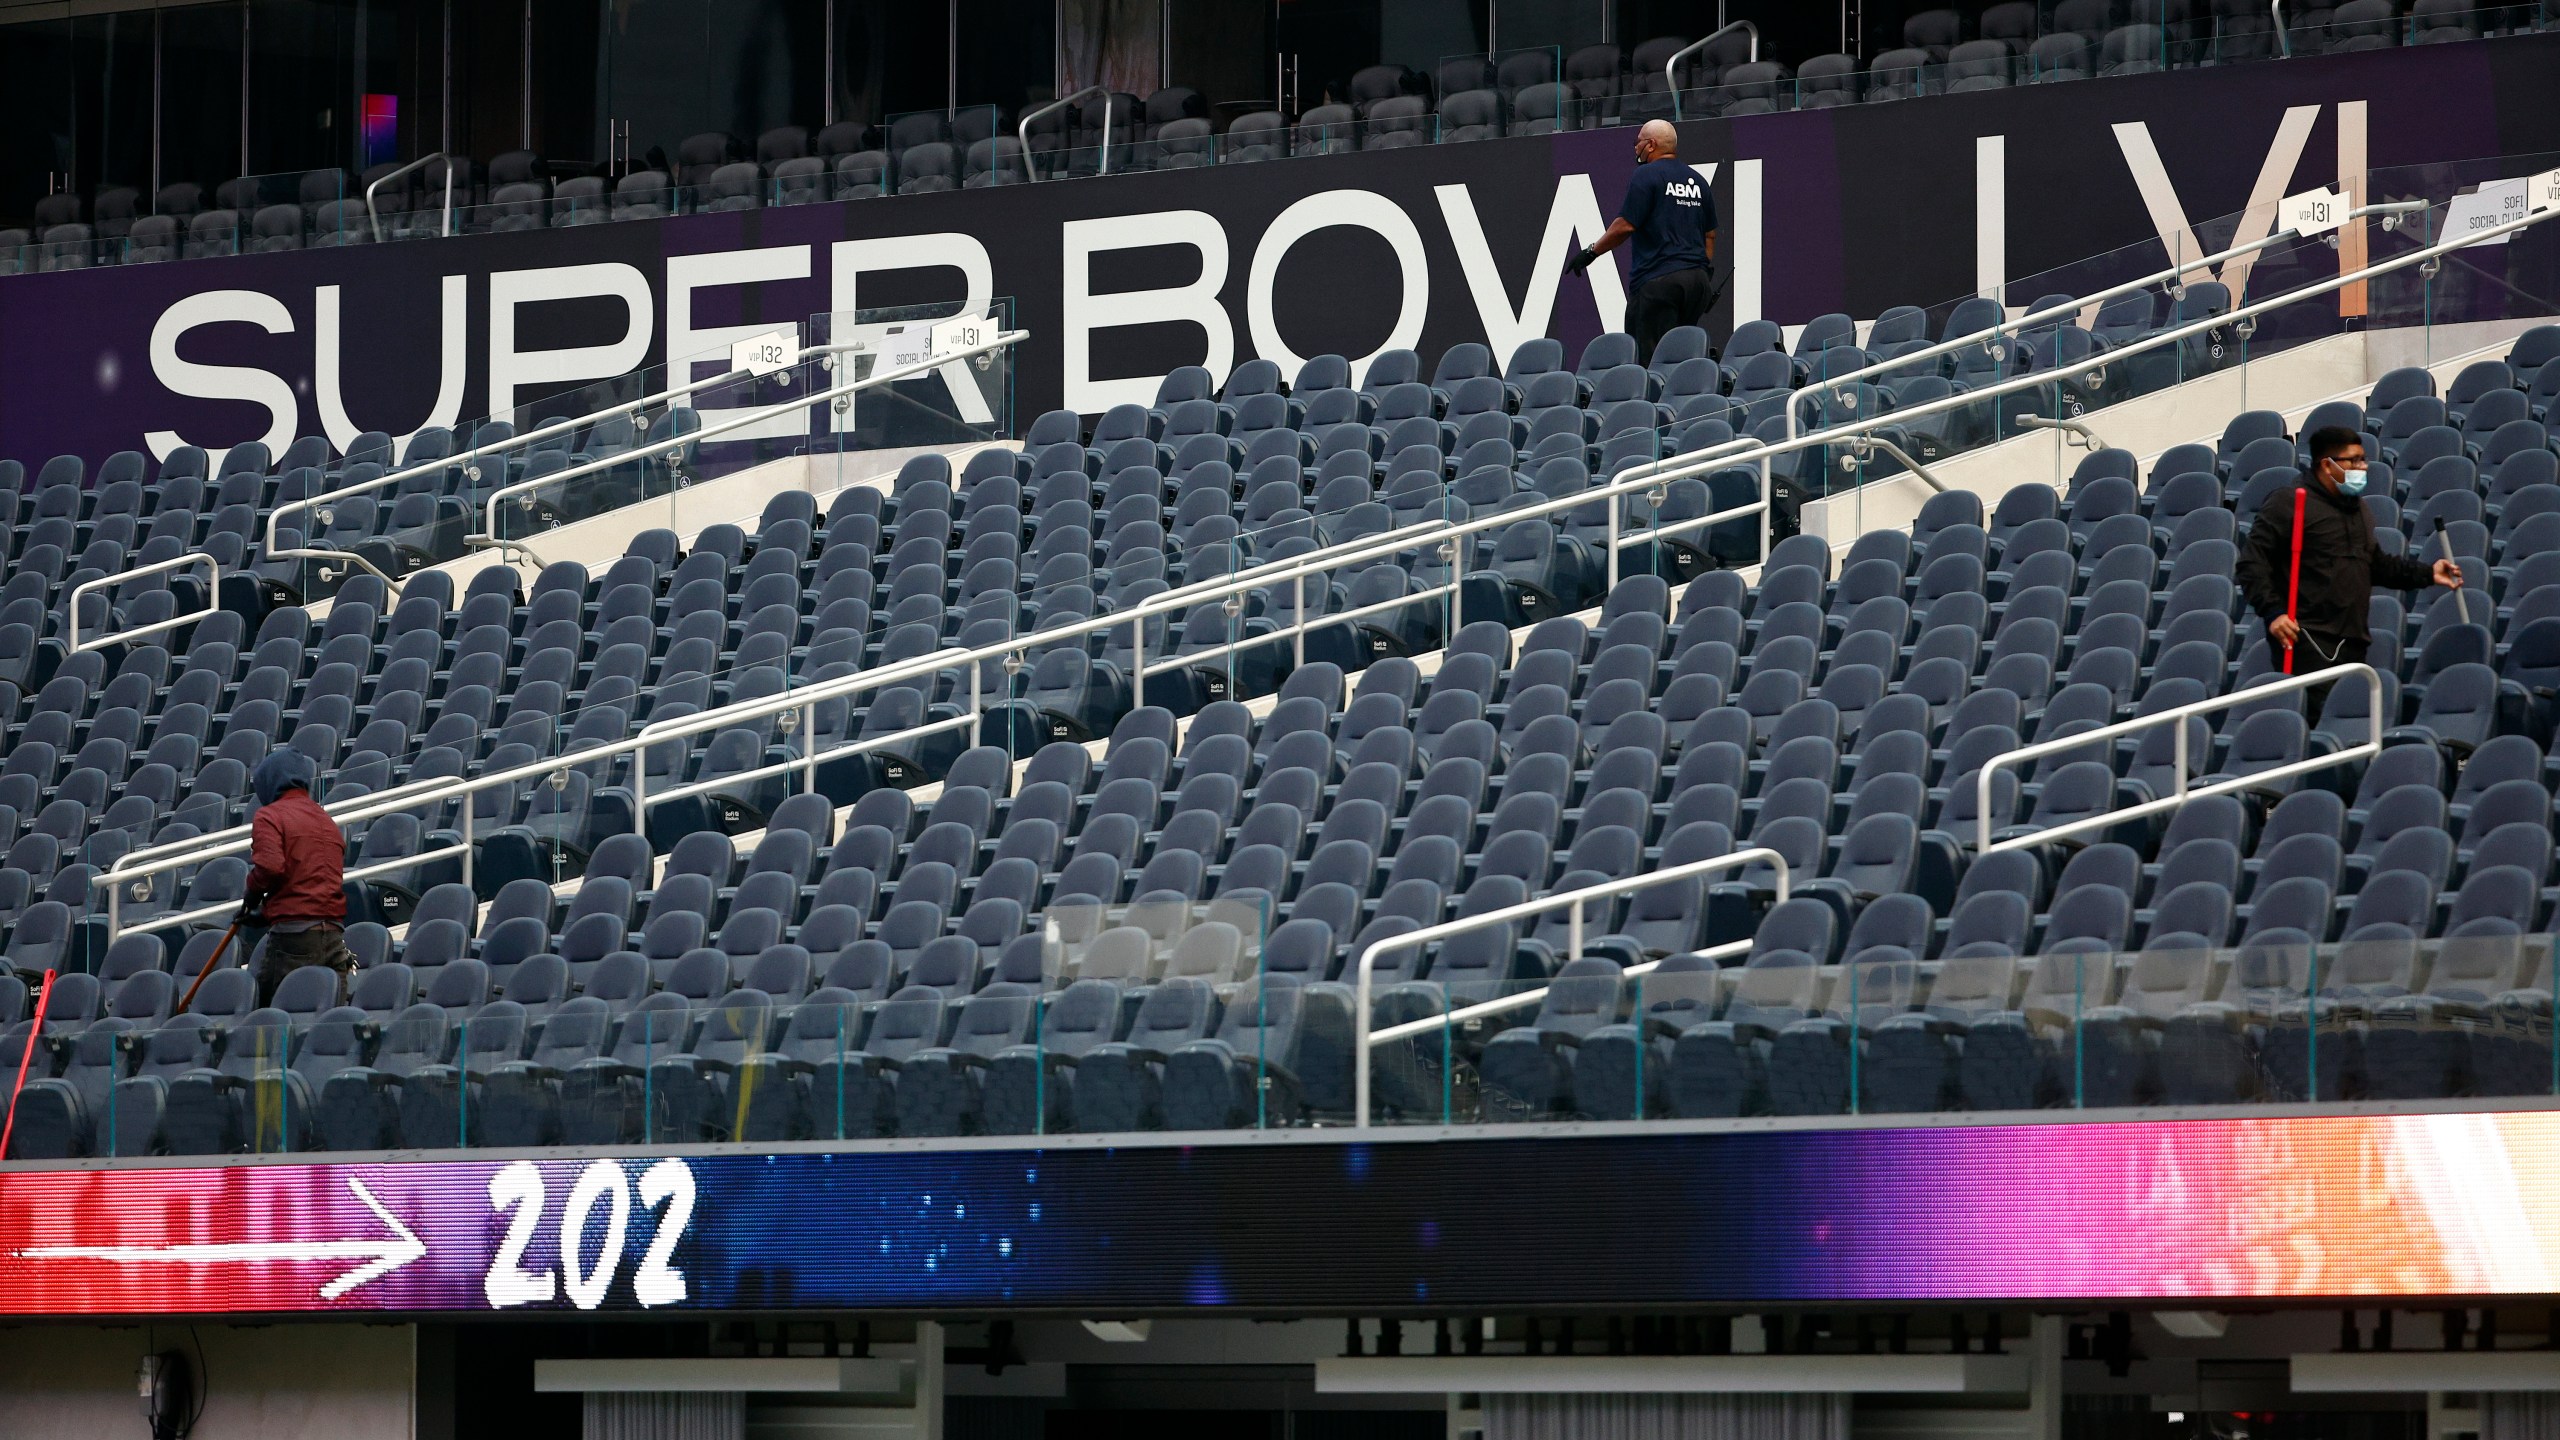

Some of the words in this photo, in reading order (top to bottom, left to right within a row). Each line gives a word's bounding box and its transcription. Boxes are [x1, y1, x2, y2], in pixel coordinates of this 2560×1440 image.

[1665, 178, 1702, 199] ABM
[2504, 195, 2523, 209] SOFI
[2469, 214, 2500, 230] SOCIAL
[143, 231, 996, 480] SUPER
[1062, 158, 1873, 416] BOWL
[1976, 100, 2368, 334] LVI
[895, 352, 920, 365] SOCIAL
[483, 1156, 697, 1311] 202
